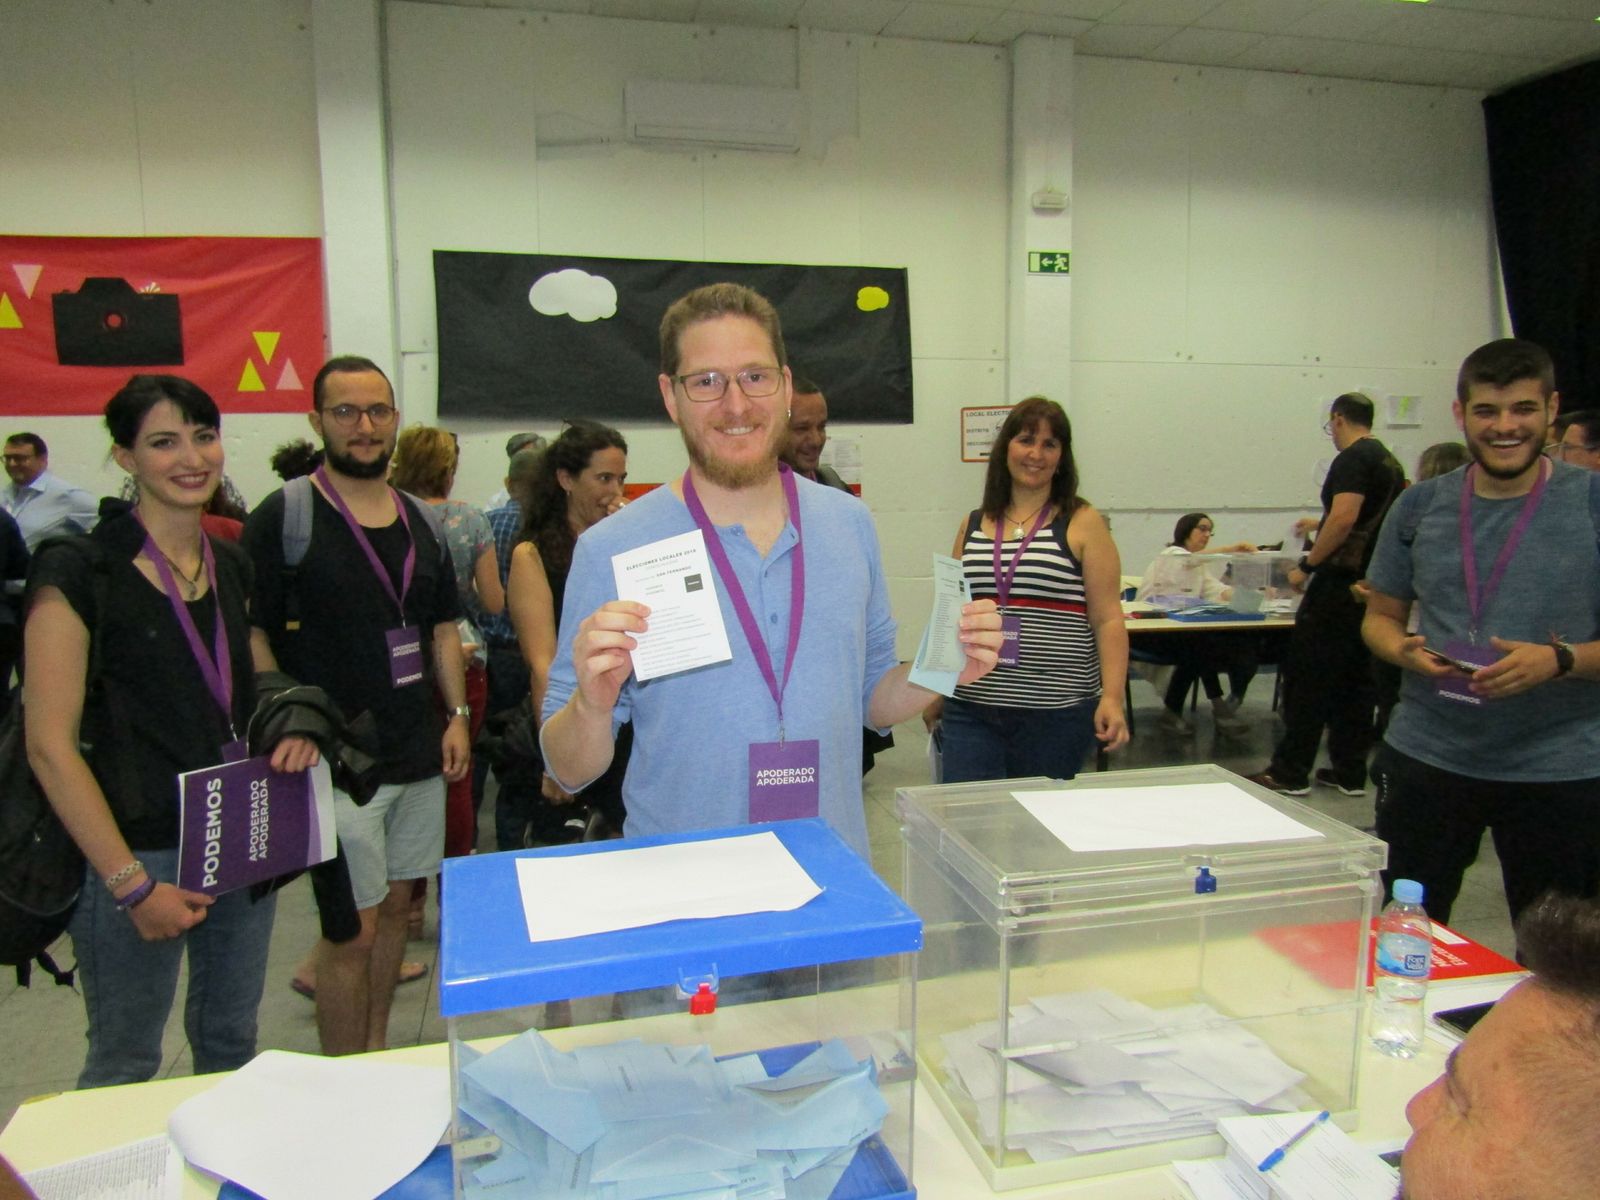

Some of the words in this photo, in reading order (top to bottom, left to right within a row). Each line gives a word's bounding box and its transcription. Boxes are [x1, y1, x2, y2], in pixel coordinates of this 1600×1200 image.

[1439, 690, 1480, 704] PODEMOS
[757, 767, 815, 778] APODERADO
[757, 775, 815, 786] APODERADA
[202, 777, 222, 888] PODEMOS
[249, 780, 260, 861] APODERADO
[258, 778, 270, 859] APODERADA
